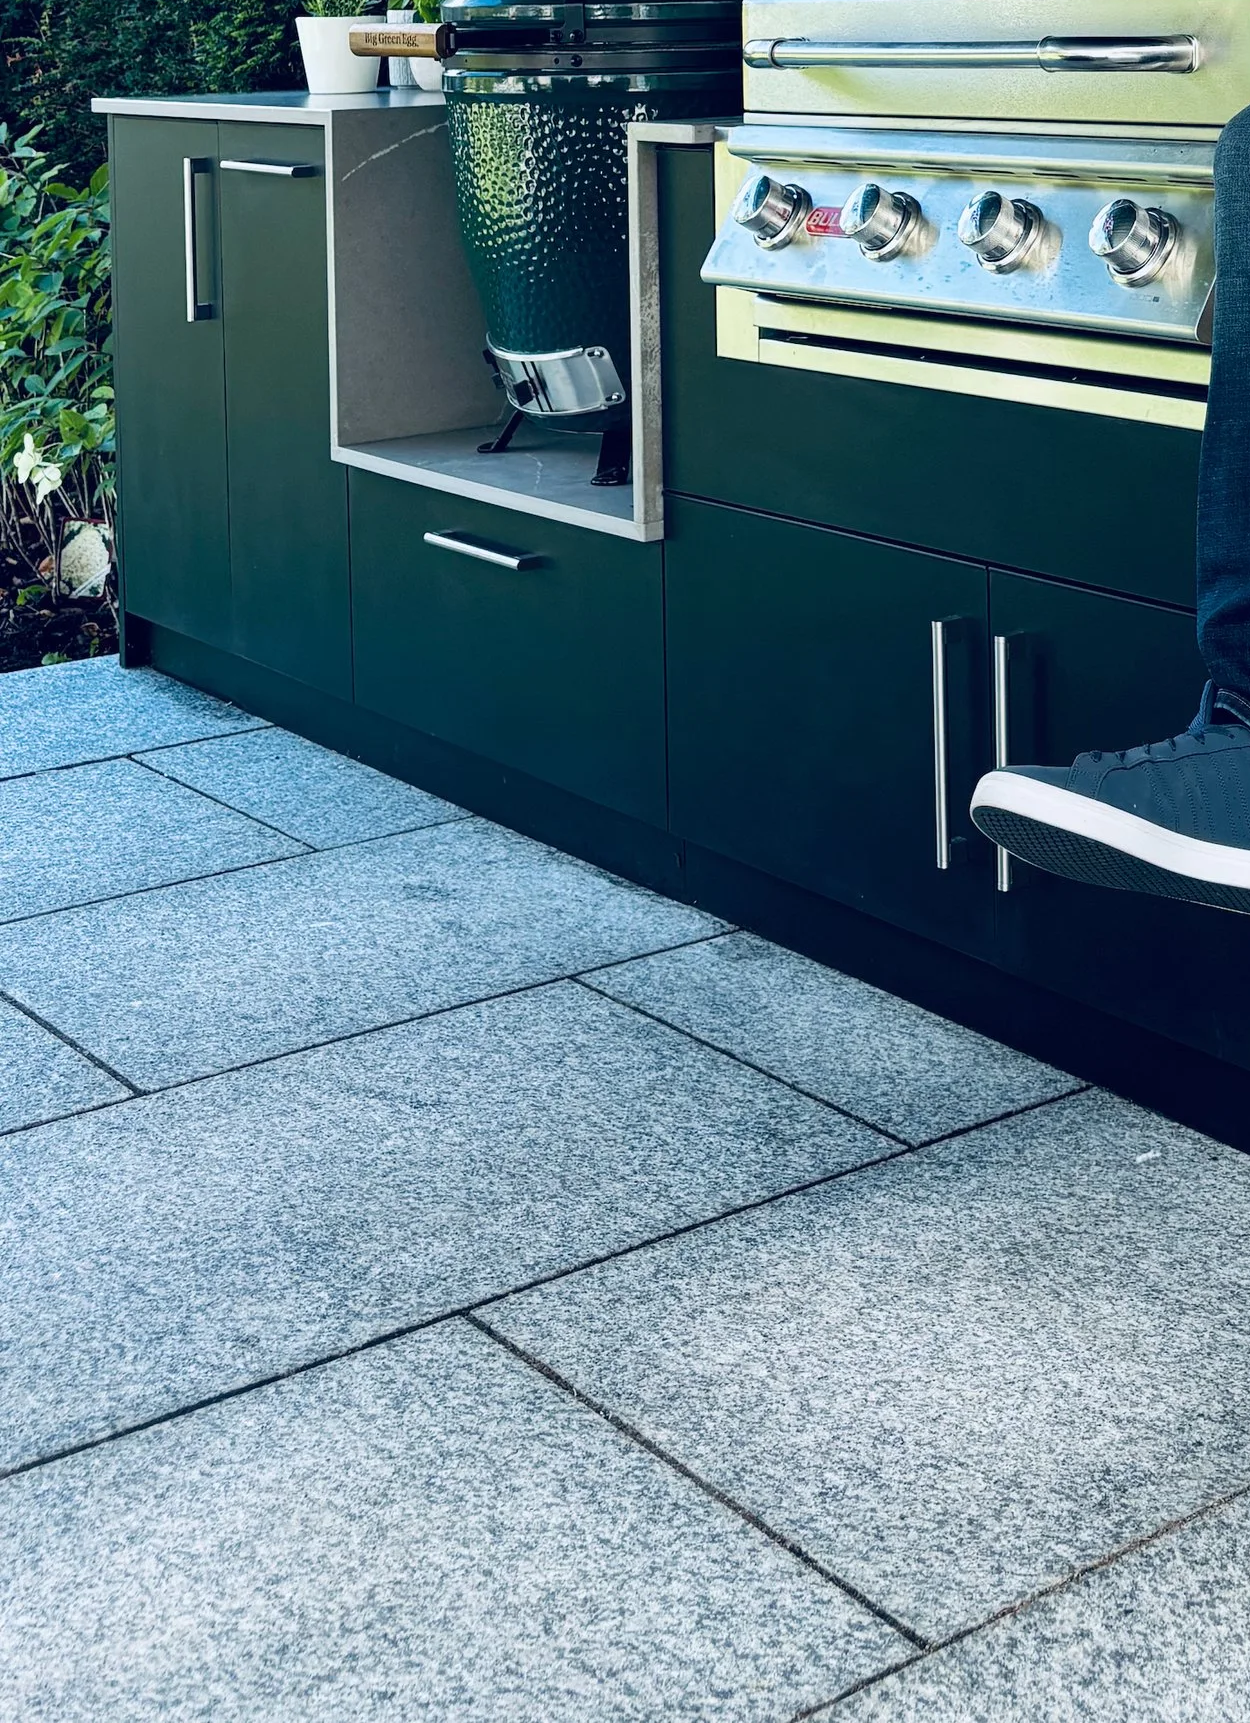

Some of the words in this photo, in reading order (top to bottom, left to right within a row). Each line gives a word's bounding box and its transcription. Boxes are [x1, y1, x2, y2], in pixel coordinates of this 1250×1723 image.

[364, 32, 378, 46] Big
[378, 32, 401, 45] Green
[402, 33, 417, 48] Egg
[807, 210, 840, 227] BUL
